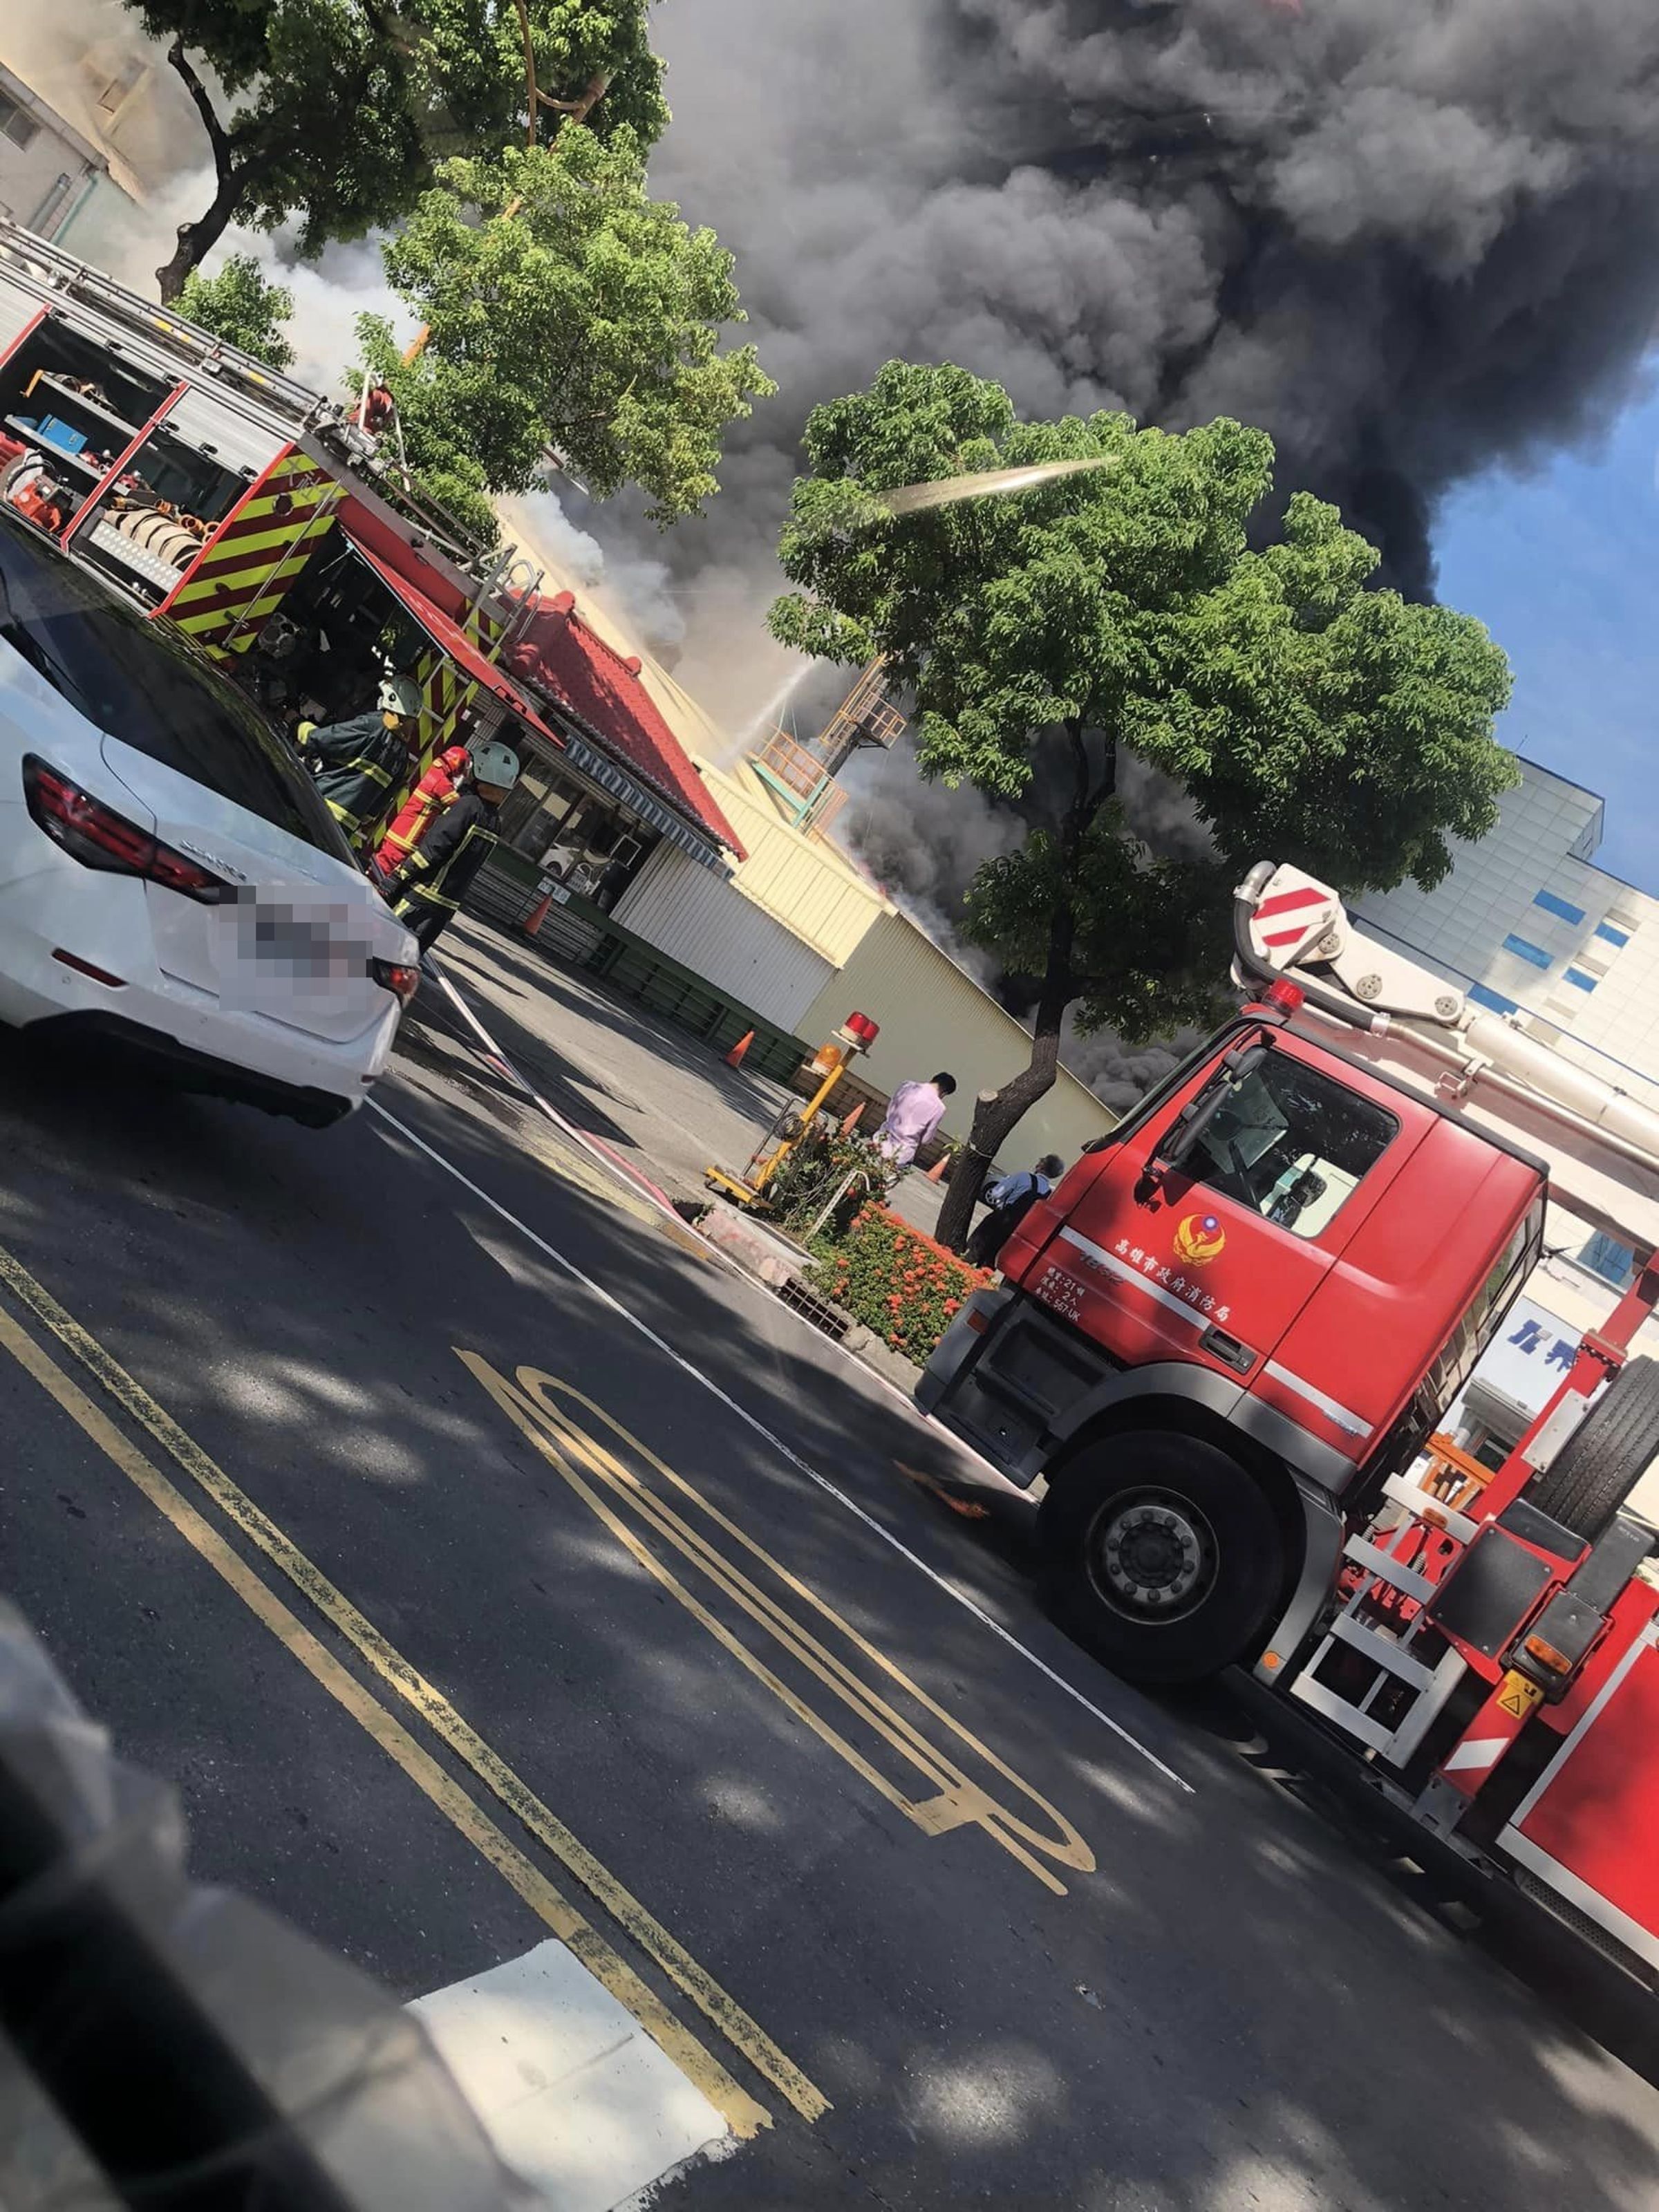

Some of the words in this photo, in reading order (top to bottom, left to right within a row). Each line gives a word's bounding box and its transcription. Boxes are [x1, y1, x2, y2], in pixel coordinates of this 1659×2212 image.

[1115, 1239, 1230, 1322] 高雄市政府消防局
